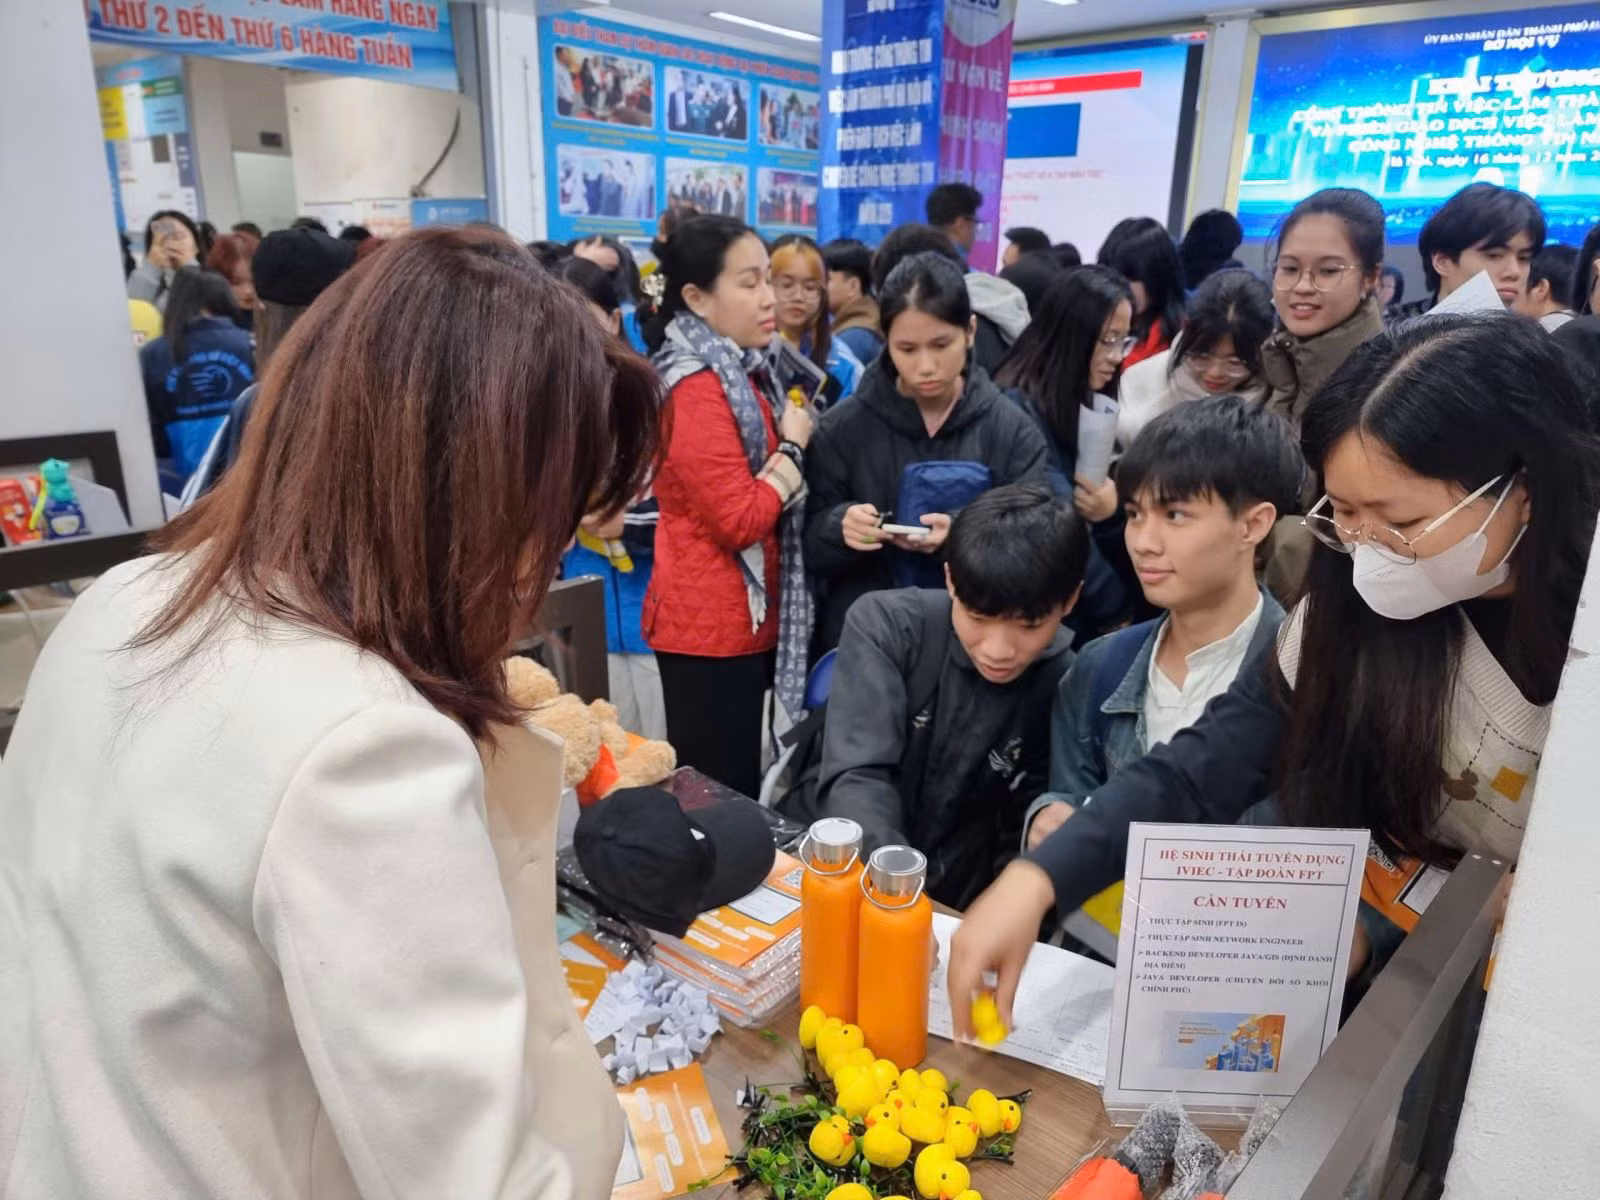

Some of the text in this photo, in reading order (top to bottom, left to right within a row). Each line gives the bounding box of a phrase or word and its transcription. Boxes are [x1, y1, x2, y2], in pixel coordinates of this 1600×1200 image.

[154, 5, 171, 34] 2
[281, 25, 293, 52] 6
[1159, 849, 1178, 862] HỆ
[1181, 850, 1214, 861] SINH
[1305, 854, 1346, 867] DỤNG
[1176, 866, 1216, 877] IVIEC
[1299, 870, 1325, 880] FPT
[1193, 919, 1214, 927] SINH
[1213, 936, 1258, 944] NETWORK
[1259, 937, 1304, 946] ENGINEER
[1145, 949, 1187, 958] BACKEND
[1187, 950, 1239, 959] DEVELOPER
[1142, 973, 1165, 982] JAVA
[1169, 974, 1220, 983] DEVELOPER
